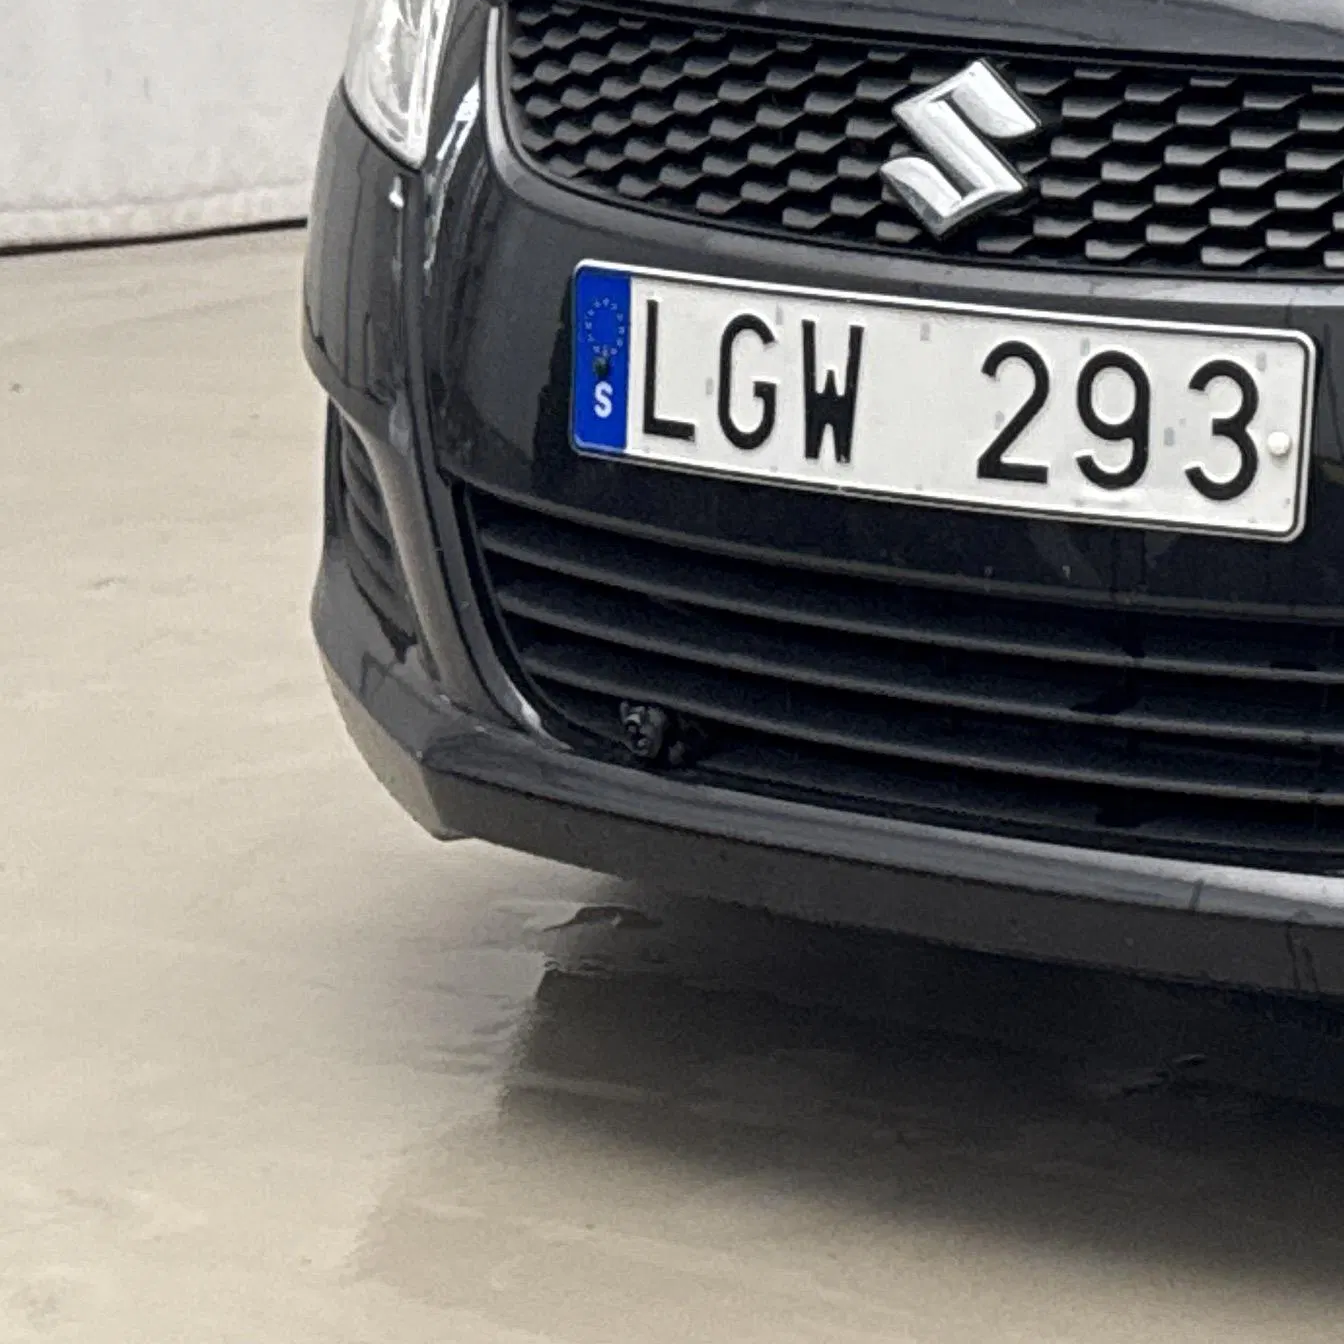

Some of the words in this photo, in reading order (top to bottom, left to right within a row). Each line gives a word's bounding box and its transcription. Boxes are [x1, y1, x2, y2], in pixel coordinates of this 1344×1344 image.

[593, 379, 614, 420] S
[643, 299, 864, 464] LGW
[976, 340, 1260, 501] 293
